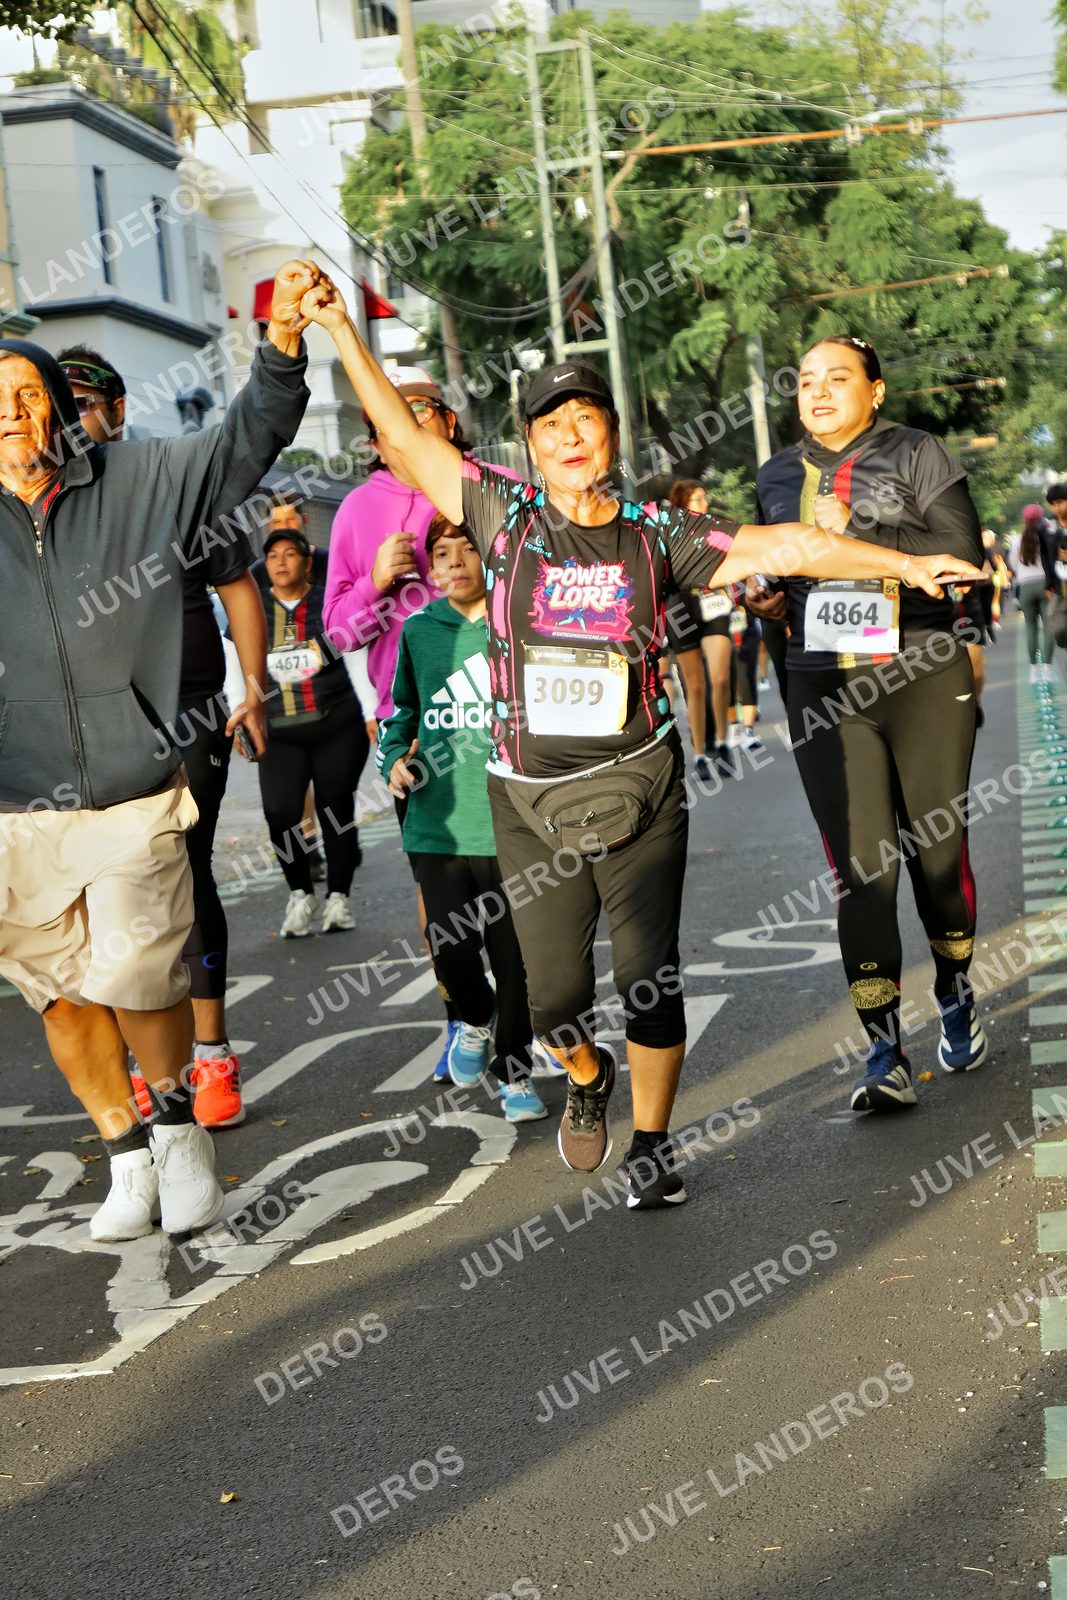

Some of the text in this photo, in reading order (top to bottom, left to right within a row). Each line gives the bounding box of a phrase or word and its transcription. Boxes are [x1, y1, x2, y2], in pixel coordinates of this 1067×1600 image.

[545, 564, 626, 587] POWER
[549, 583, 617, 612] LORE
[817, 601, 878, 626] 4864
[275, 655, 309, 671] 4671
[534, 676, 604, 706] 3099
